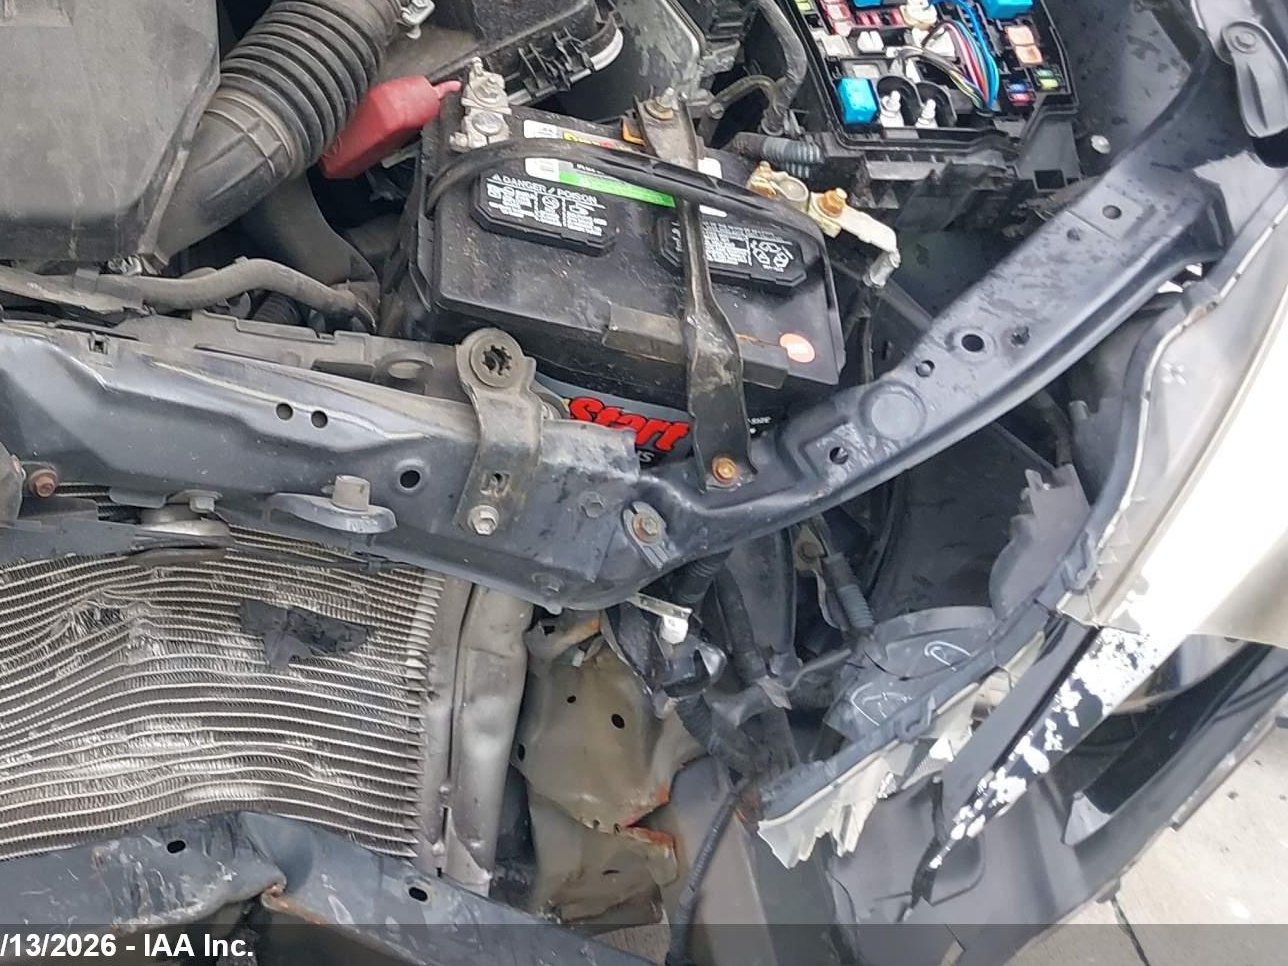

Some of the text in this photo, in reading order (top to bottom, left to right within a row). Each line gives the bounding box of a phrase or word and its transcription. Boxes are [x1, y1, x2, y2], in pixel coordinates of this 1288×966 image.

[502, 175, 547, 193] DANGER
[557, 187, 598, 204] POISON
[569, 396, 691, 452] Start
